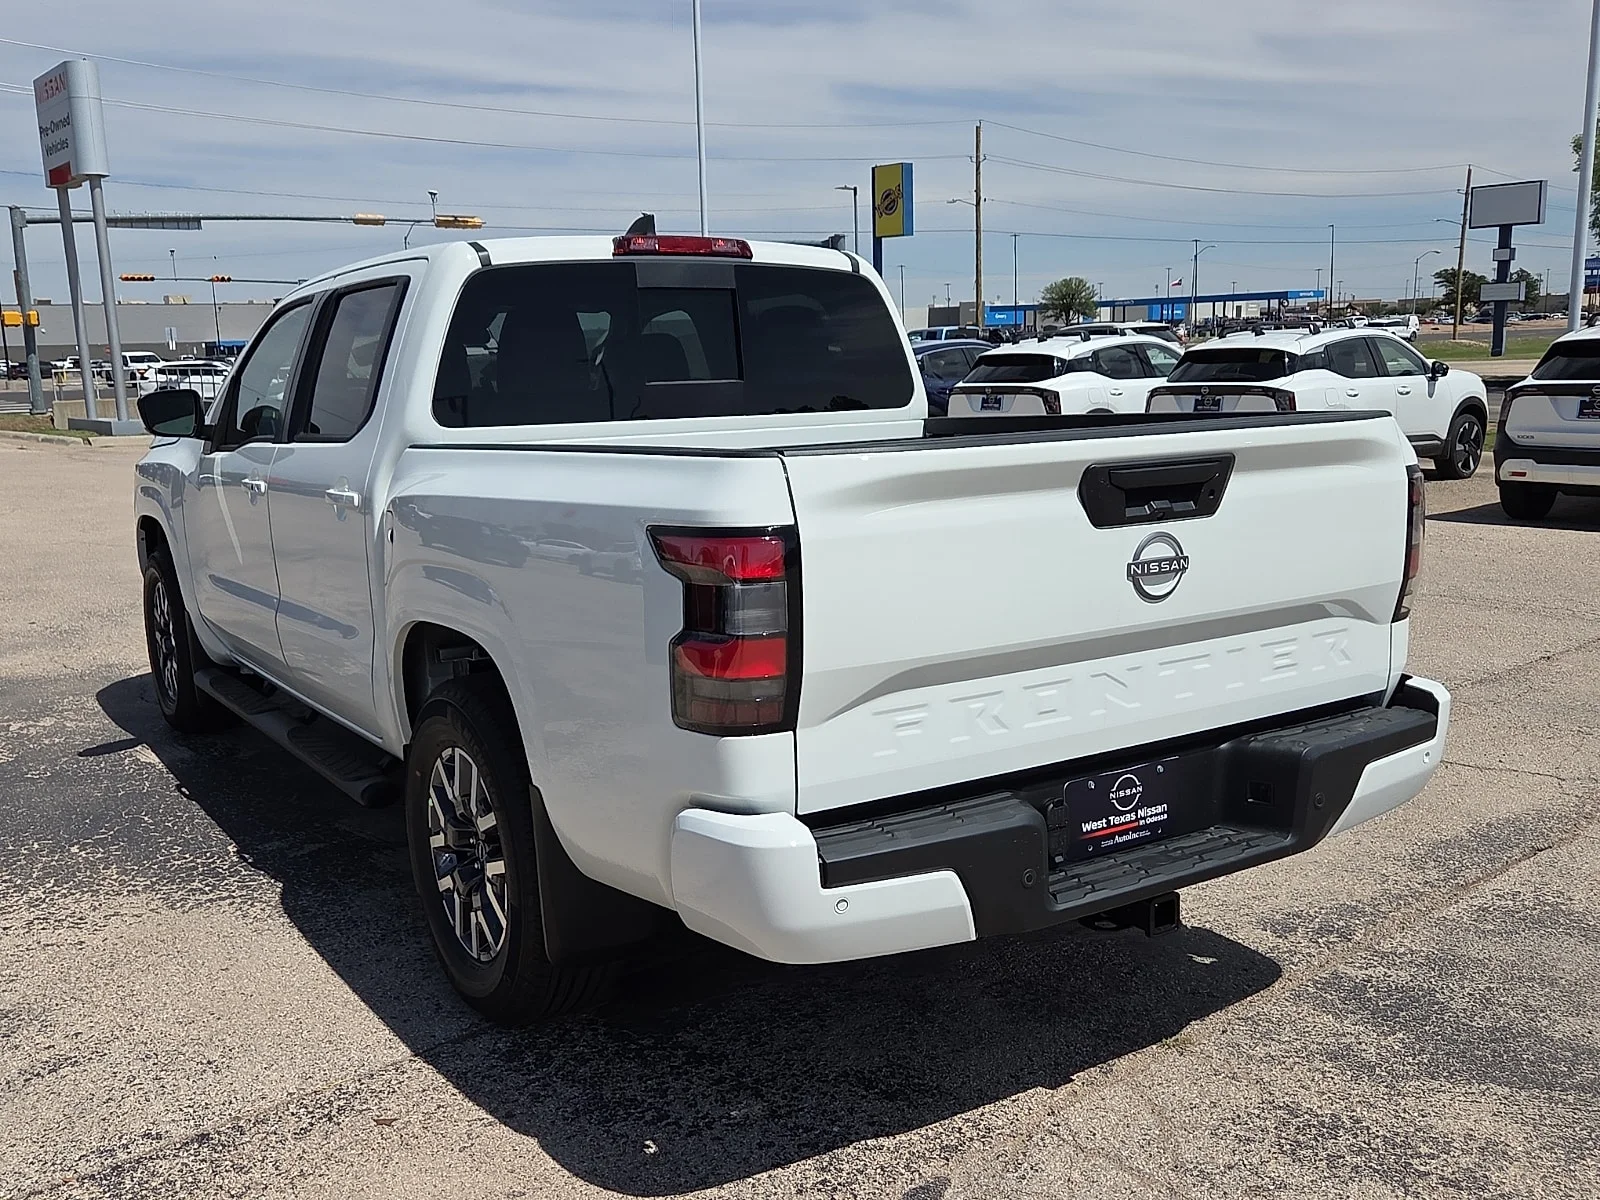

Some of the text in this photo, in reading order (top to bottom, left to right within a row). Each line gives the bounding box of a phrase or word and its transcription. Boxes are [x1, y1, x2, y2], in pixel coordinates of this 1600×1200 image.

[39, 112, 70, 139] Pre-Owned
[44, 138, 69, 157] Vehicles
[1130, 558, 1188, 575] NISSAN
[872, 627, 1353, 757] FRONTIER
[1109, 785, 1143, 800] NISSAN
[1081, 803, 1168, 833] West Texas Nissan
[1146, 814, 1168, 824] Odessa
